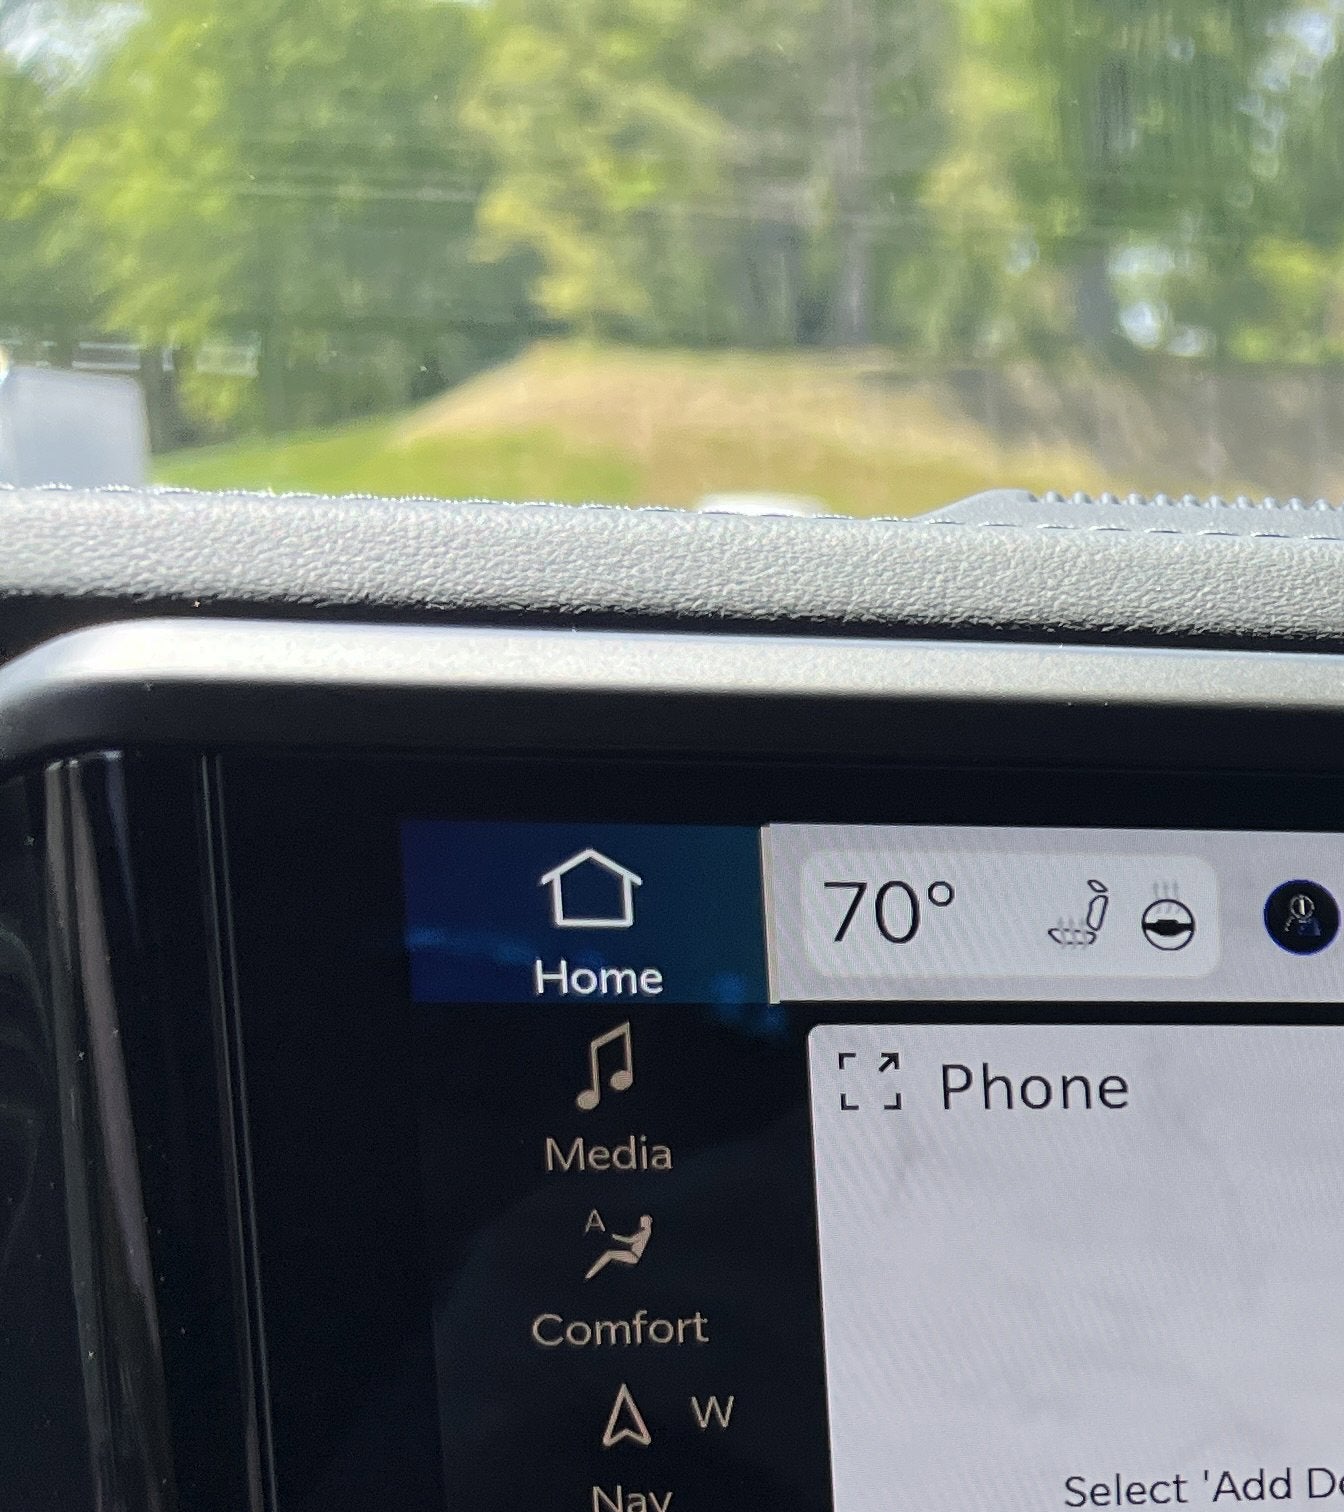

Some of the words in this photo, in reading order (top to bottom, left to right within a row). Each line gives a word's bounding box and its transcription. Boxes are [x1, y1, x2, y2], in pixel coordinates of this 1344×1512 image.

[823, 880, 955, 945] 70°
[535, 959, 664, 995] Home
[942, 1062, 1128, 1110] Phone
[546, 1135, 672, 1171] Media
[532, 1309, 710, 1346] Comfort
[691, 1395, 735, 1429] W
[1064, 1472, 1188, 1508] Select
[1204, 1466, 1292, 1503] 'Add
